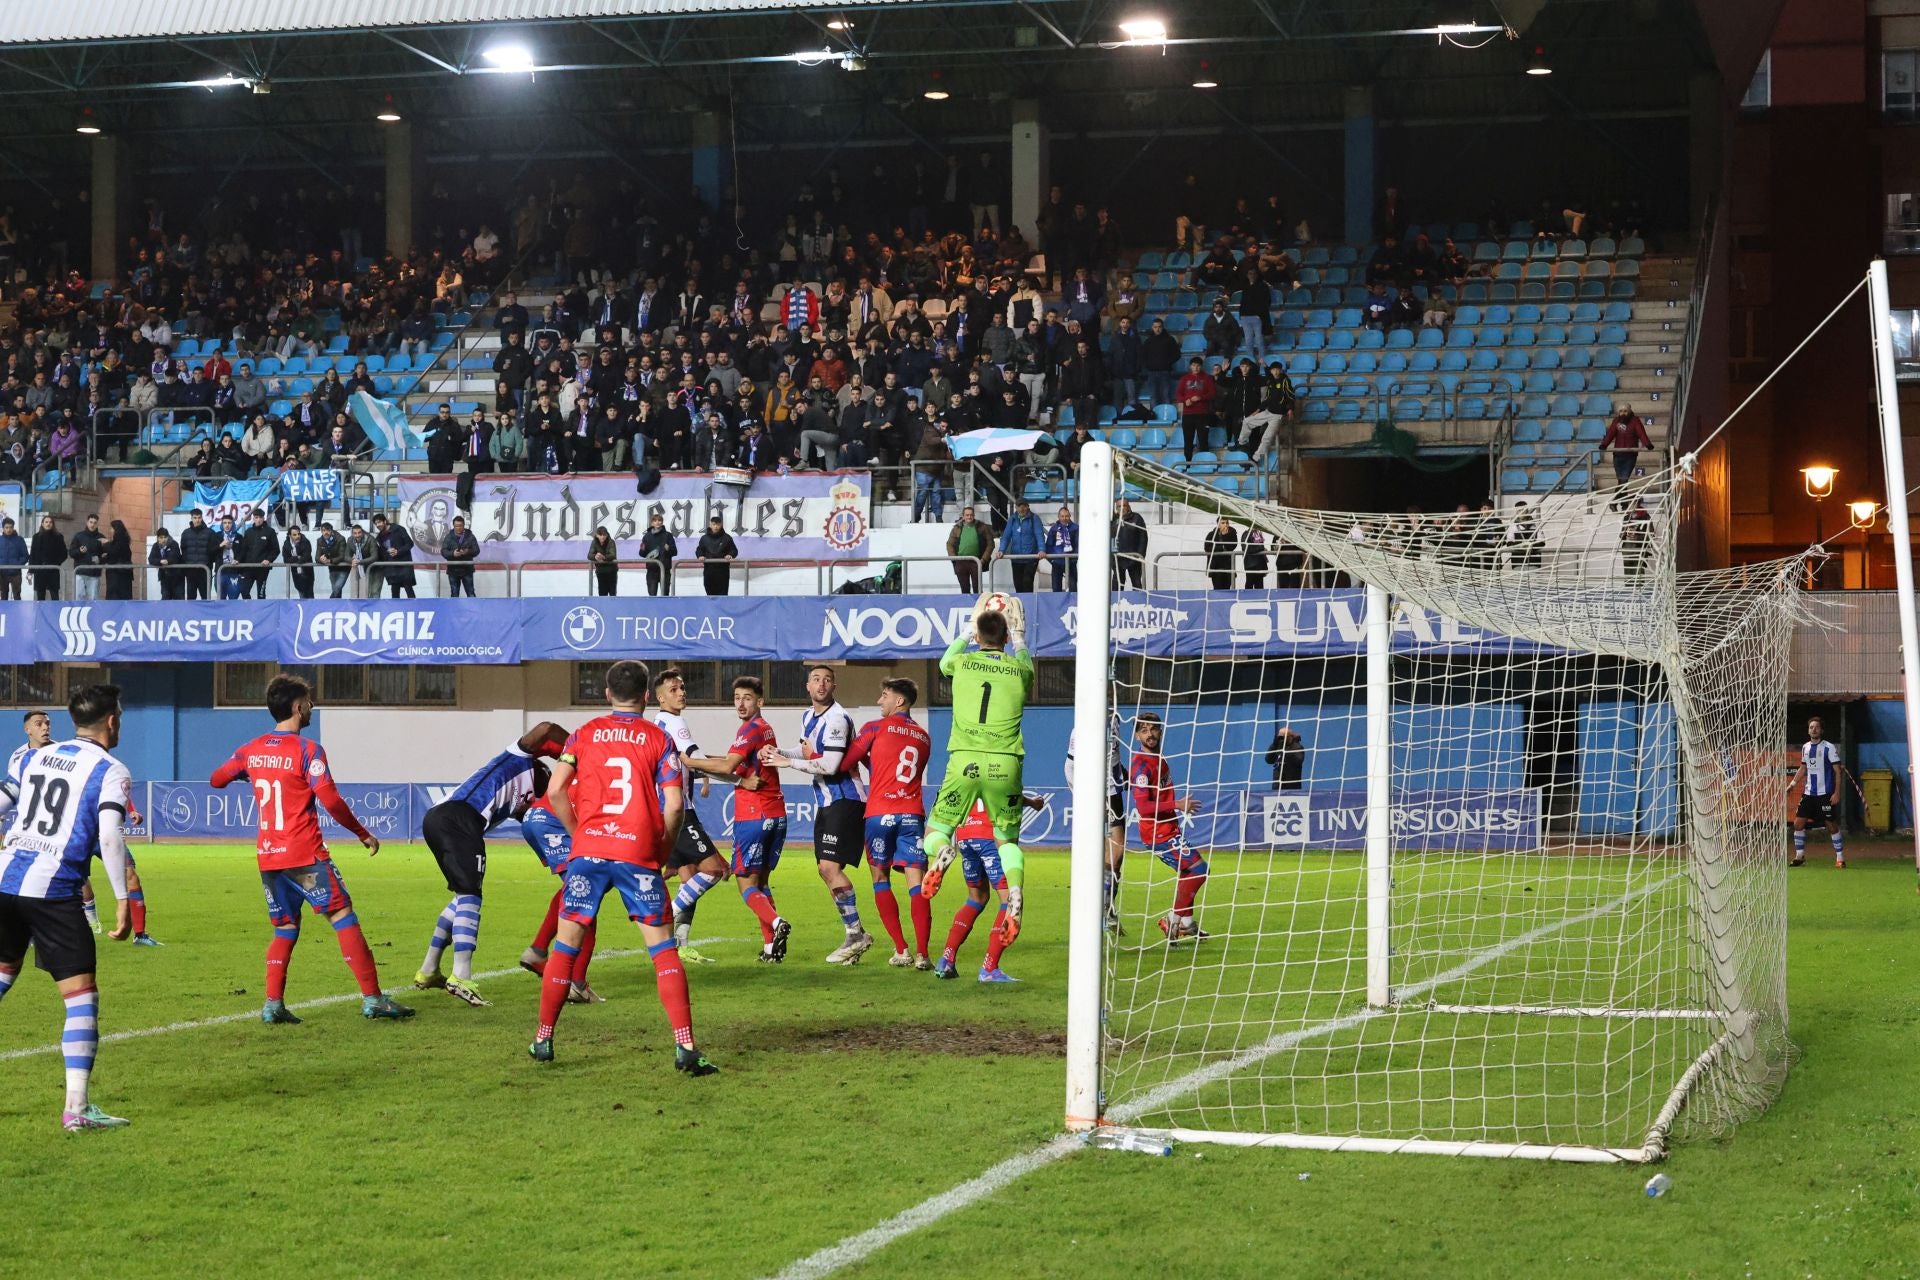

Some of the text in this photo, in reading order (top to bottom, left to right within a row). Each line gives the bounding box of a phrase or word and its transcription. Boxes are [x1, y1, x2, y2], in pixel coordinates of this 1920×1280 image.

[290, 483, 335, 500] FANS
[101, 619, 254, 643] SANIASTUR
[310, 611, 435, 643] ARNAIZ
[616, 615, 735, 640] TRIOCAR
[397, 644, 503, 656] CLÍNICA PODOLÓGICA
[979, 681, 992, 724] 1
[592, 728, 647, 746] BONILLA
[39, 754, 77, 773] NATALIO
[247, 755, 294, 771] CRISTIAN D.
[895, 745, 919, 784] 8
[602, 757, 632, 814] 3
[22, 774, 70, 837] 19
[255, 778, 284, 831] 21
[1319, 808, 1520, 832] INVRSIONES
[132, 827, 145, 835] 273
[585, 828, 636, 841] Caja Soria
[687, 825, 700, 840] 5
[544, 845, 570, 857] Soria
[634, 891, 661, 901] Soria
